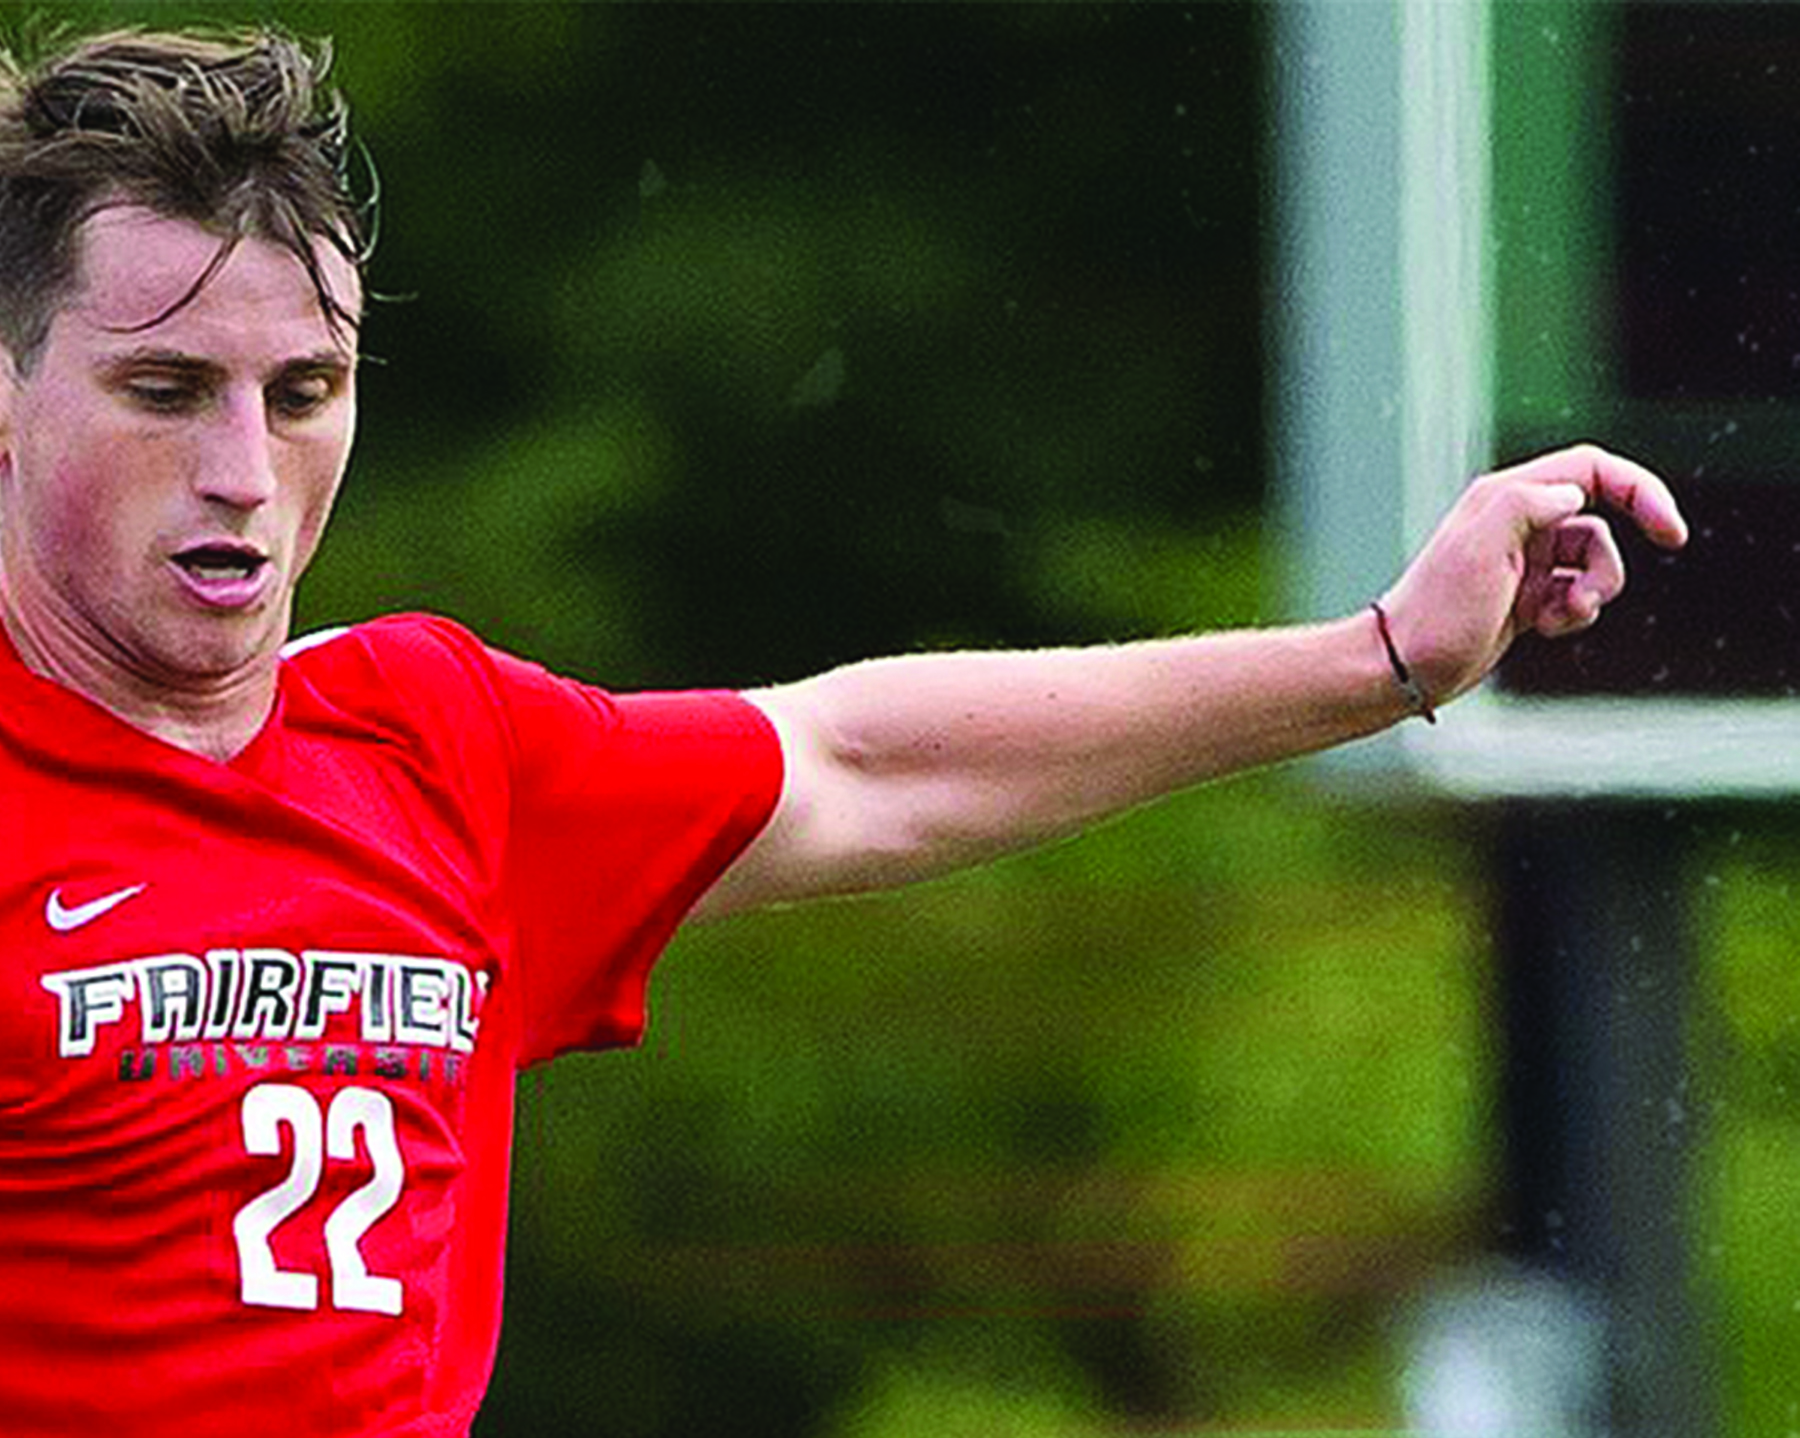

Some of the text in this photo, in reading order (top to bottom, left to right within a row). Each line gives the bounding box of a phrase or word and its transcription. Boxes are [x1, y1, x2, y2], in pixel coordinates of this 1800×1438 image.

[40, 948, 489, 1058] FAIRFIEL
[118, 1044, 468, 1082] UNIVERSIT
[232, 1082, 405, 1317] 22
